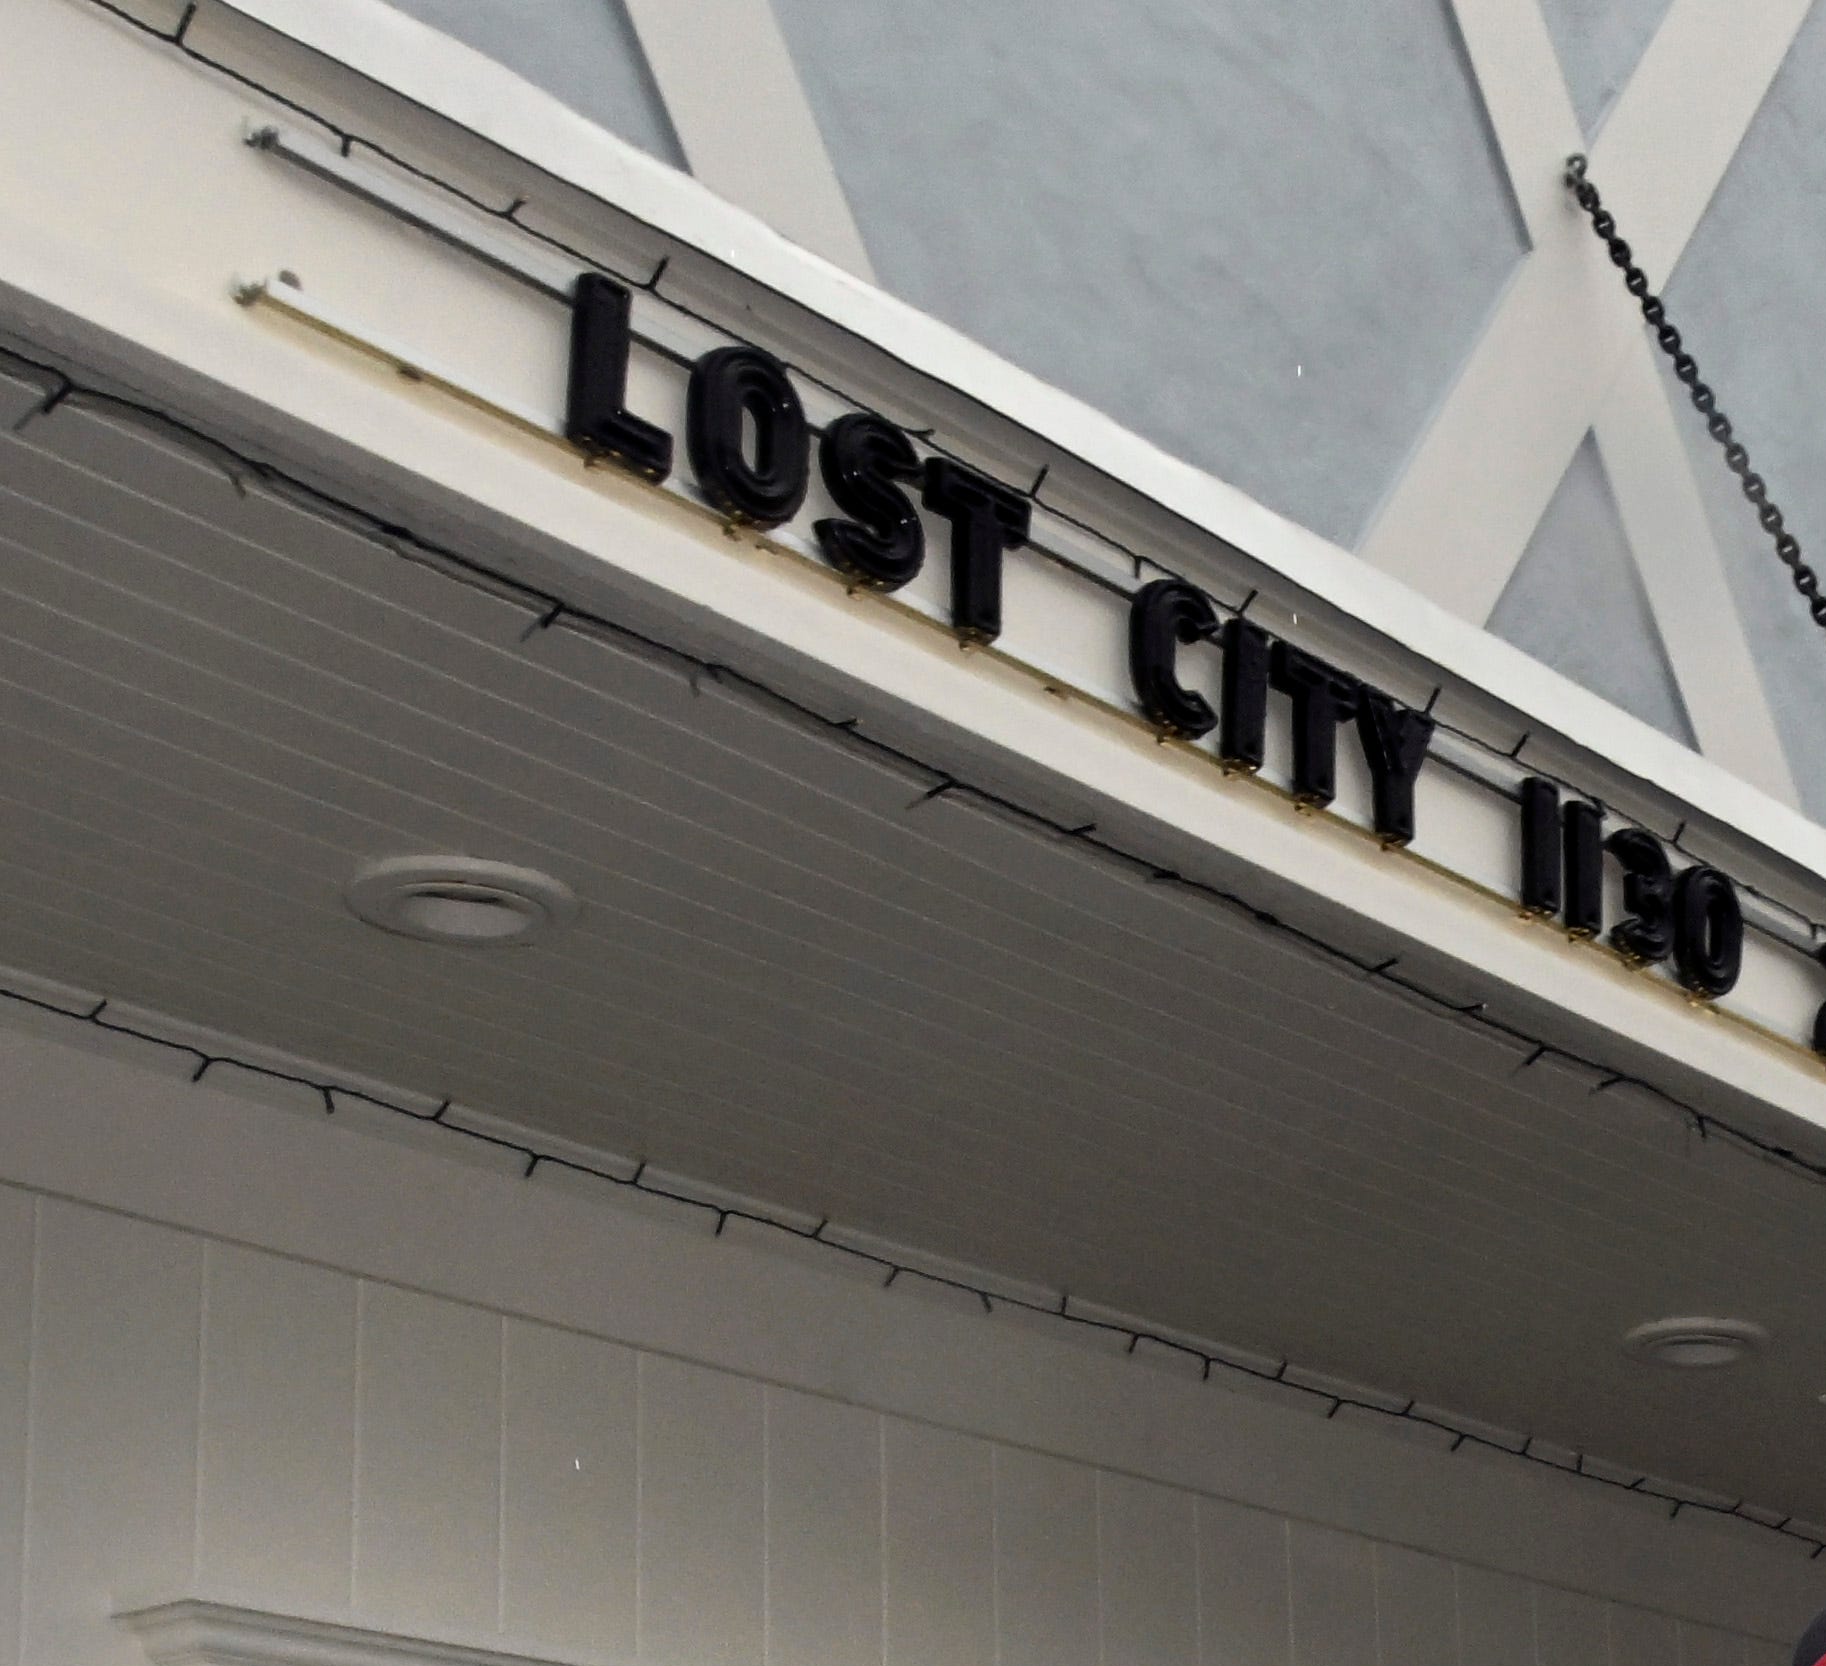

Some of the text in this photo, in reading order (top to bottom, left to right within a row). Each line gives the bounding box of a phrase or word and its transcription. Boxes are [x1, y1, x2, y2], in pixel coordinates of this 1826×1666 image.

[566, 271, 1032, 645] LOST
[1128, 578, 1436, 845] CITY
[1519, 776, 1743, 997] 1130
